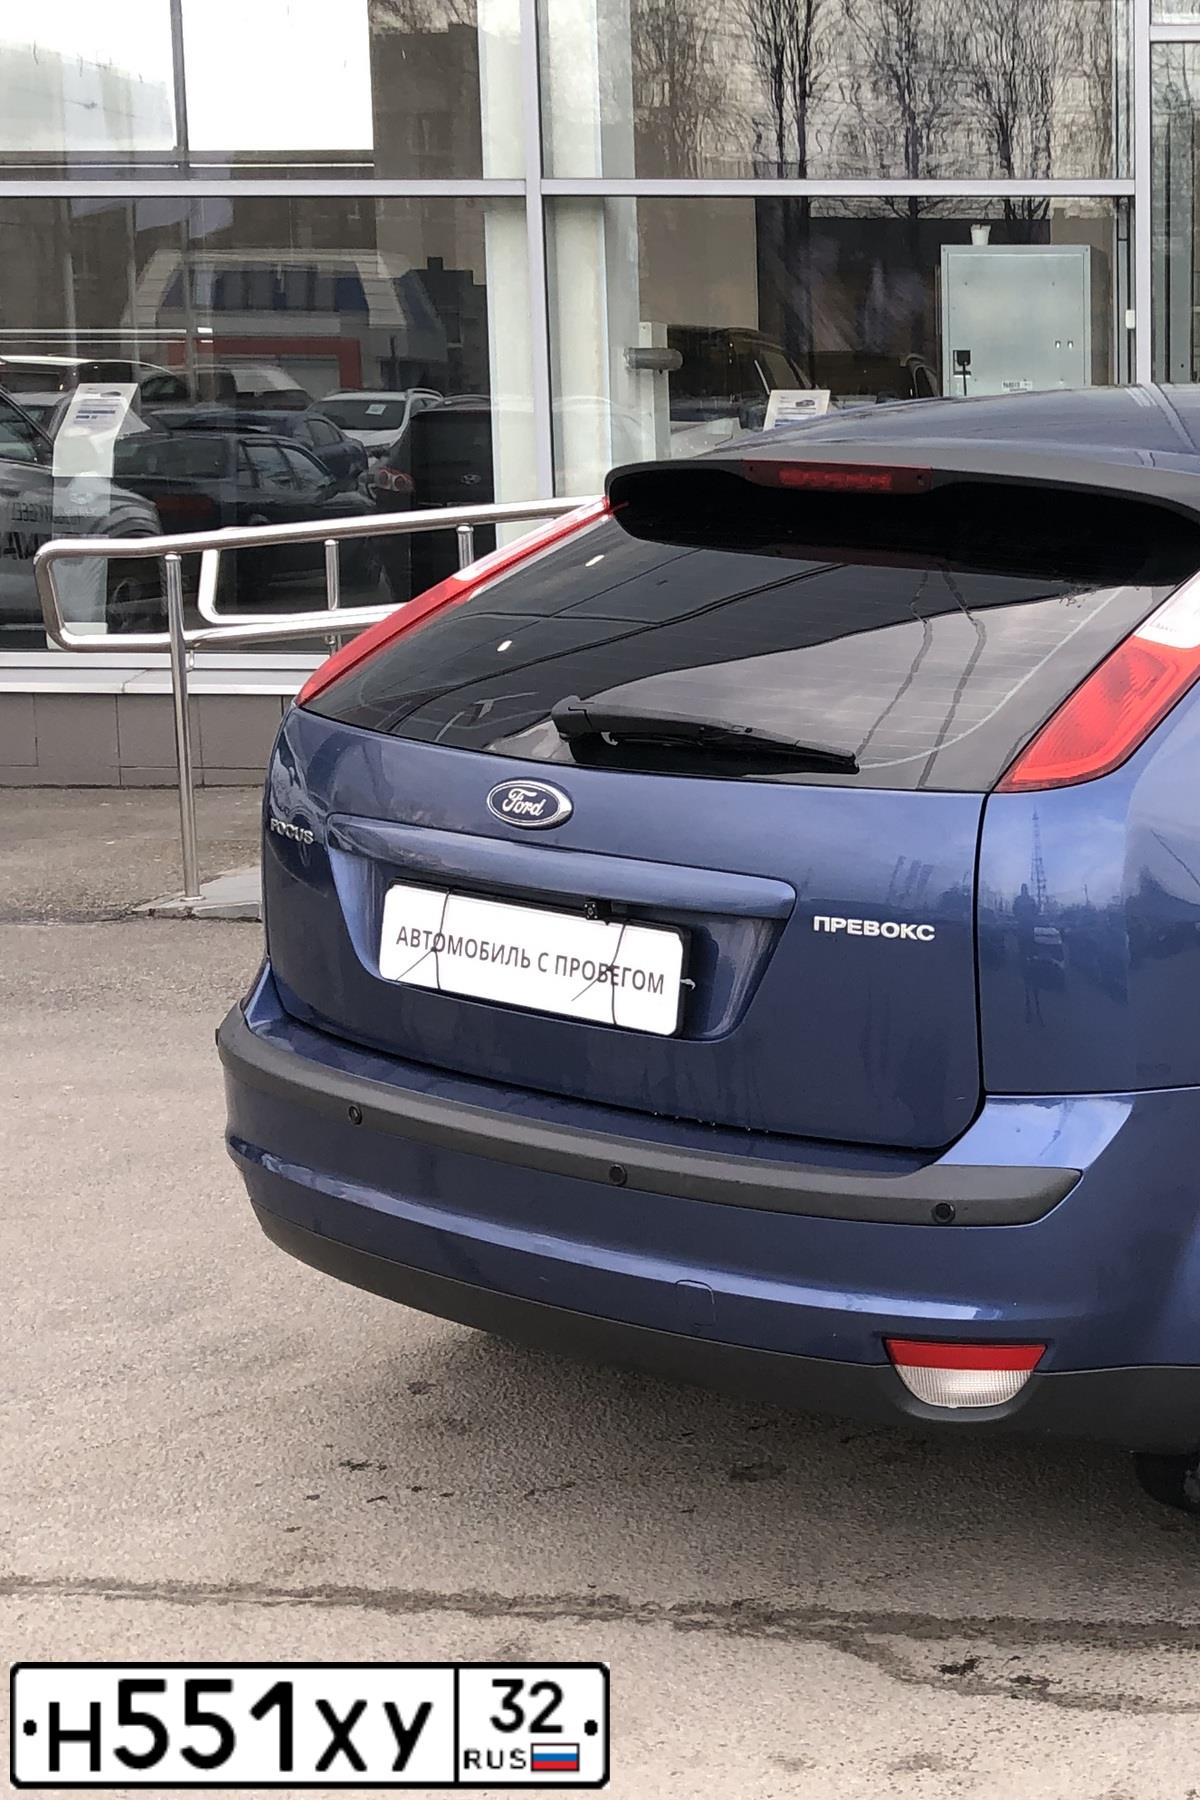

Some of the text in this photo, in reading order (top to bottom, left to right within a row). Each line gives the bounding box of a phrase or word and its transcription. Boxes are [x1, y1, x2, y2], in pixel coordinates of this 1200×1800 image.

[502, 787, 547, 816] Ford
[270, 818, 314, 844] FOCUS
[813, 915, 936, 941] ПРЕВОКС
[396, 926, 665, 995] АВТОМОБИЛЬ С ПРОБЕГОМ
